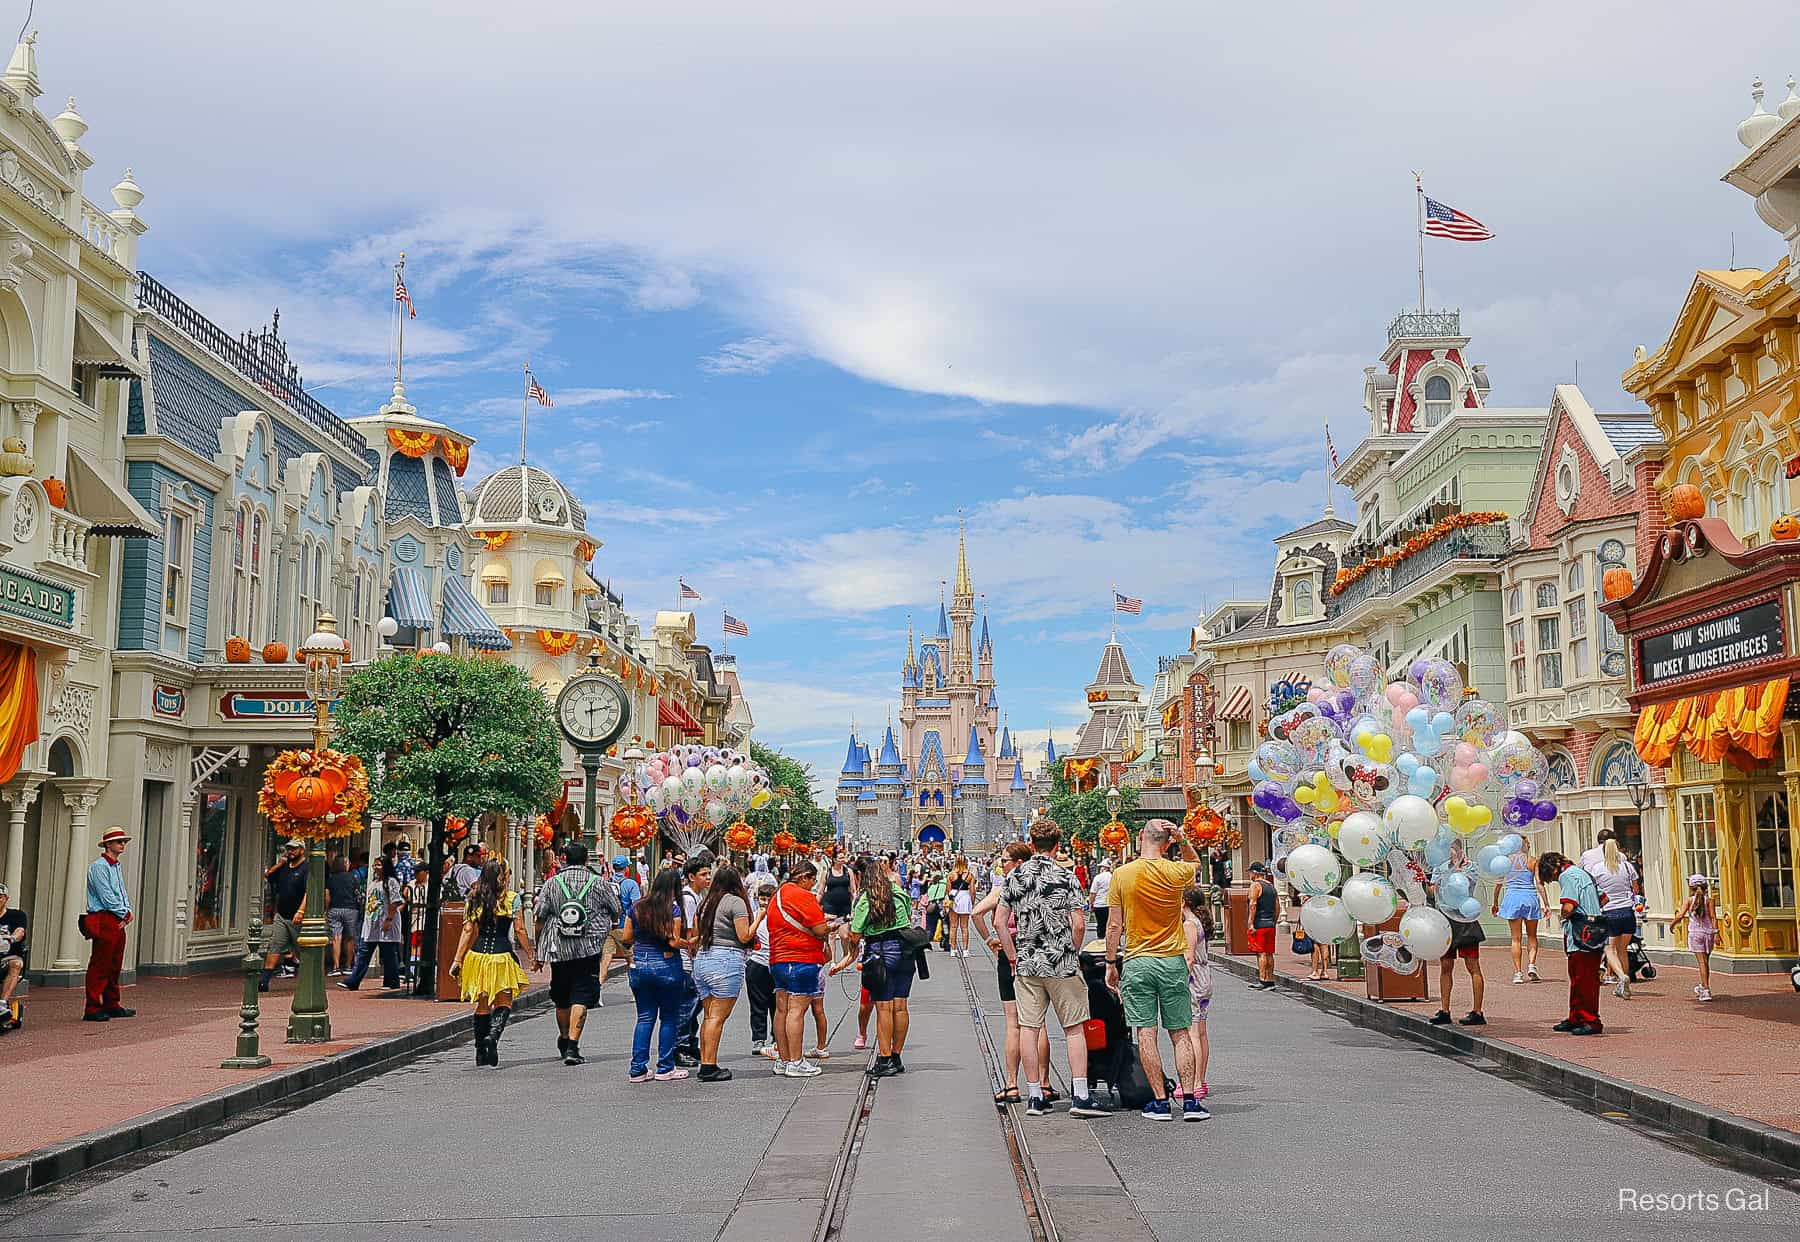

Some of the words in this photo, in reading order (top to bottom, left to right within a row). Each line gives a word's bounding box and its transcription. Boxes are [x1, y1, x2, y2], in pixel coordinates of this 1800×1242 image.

[0, 577, 63, 614] CADE
[1672, 630, 1692, 650] NOW
[1697, 616, 1740, 644] SHOWING
[1653, 656, 1683, 680] MICKEY
[1688, 634, 1768, 671] MOUSETERPIECES
